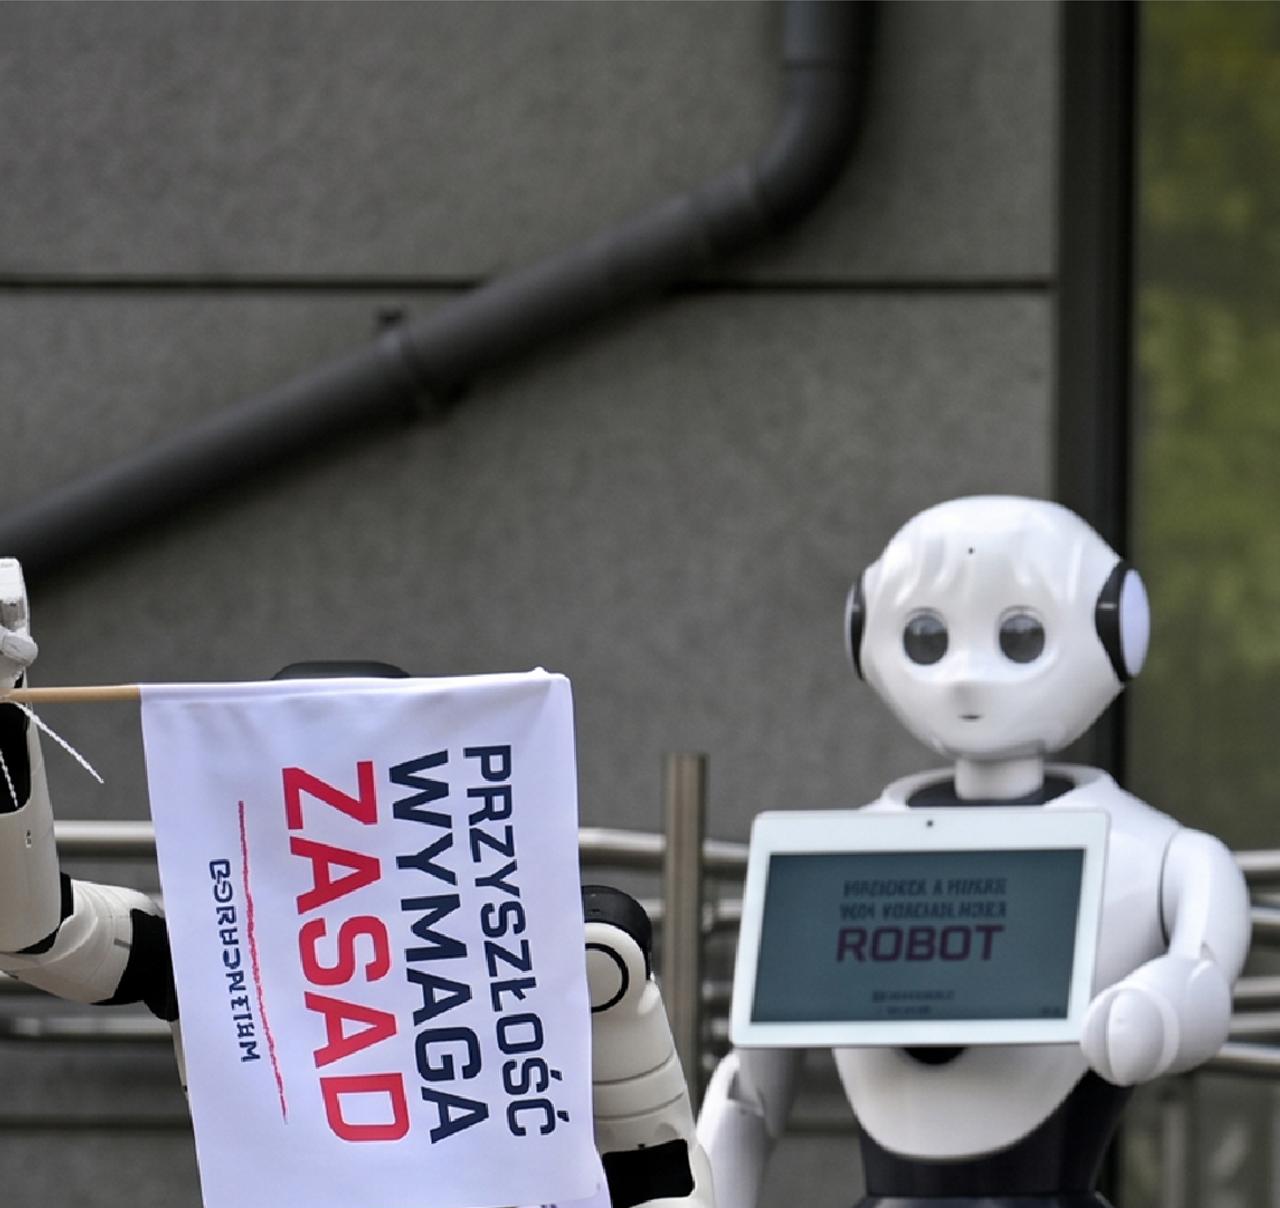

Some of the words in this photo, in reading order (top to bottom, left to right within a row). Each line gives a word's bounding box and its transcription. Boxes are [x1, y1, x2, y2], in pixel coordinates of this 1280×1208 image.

[282, 760, 411, 1143] ZASAD
[388, 749, 490, 1146] WYMAGA
[463, 743, 571, 1138] PRZYSZŁOŚĆ
[836, 924, 1004, 963] ROBOT
